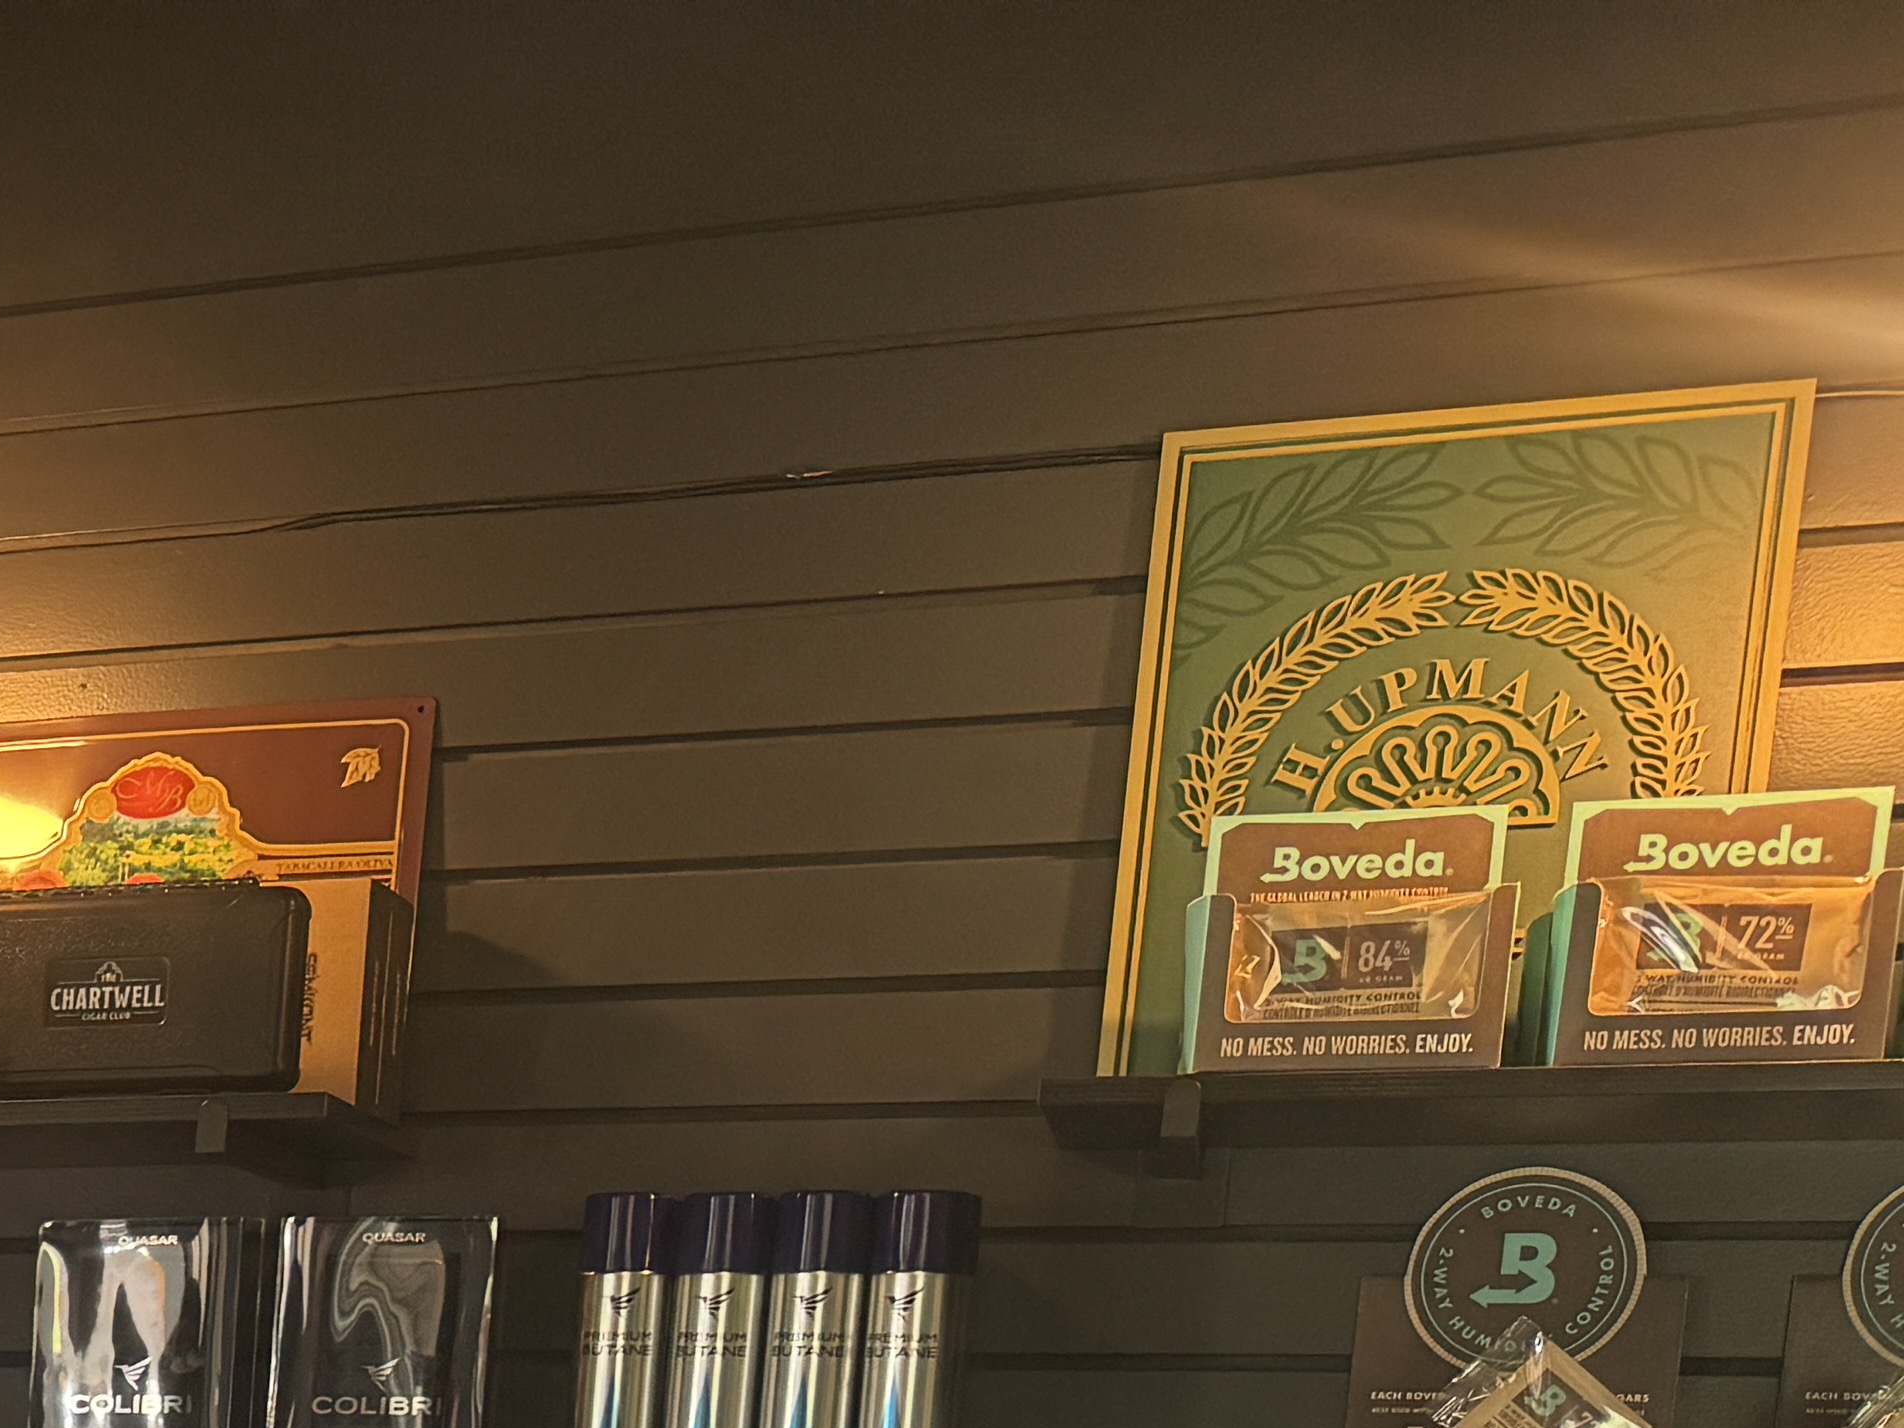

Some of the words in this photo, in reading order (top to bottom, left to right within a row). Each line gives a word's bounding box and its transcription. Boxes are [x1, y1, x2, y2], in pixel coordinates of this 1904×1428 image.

[1325, 658, 1608, 782] UPMANN
[1260, 839, 1445, 883] Boveda
[1623, 824, 1824, 872] Boveda
[1738, 914, 1794, 949] 72%
[1358, 939, 1410, 973] 84%
[1679, 975, 1736, 986] HUMIDITY
[50, 984, 165, 1011] CHARTWELL
[1365, 991, 1422, 1003] CONTROL
[1220, 1036, 1244, 1058] NO
[1247, 1036, 1297, 1057] MESS.
[1302, 1035, 1327, 1056] NO
[1330, 1034, 1410, 1056] WORRIES.
[1415, 1032, 1473, 1054] ENJOY.
[1584, 1031, 1608, 1051] NO
[1612, 1029, 1666, 1050] MESS.
[1672, 1028, 1697, 1049] NO
[1702, 1026, 1787, 1047] WORRIES.
[1792, 1023, 1855, 1045] ENJOY.
[1480, 1195, 1578, 1219] BOVEDA
[118, 1234, 179, 1247] QUASAR
[363, 1231, 426, 1244] QUASAR
[1434, 1246, 1455, 1313] 2-WAY
[1566, 1245, 1614, 1336] CONTROL
[70, 1394, 192, 1416] COLIBRI
[312, 1396, 441, 1416] COLIBRI
[1370, 1391, 1402, 1400] EACH
